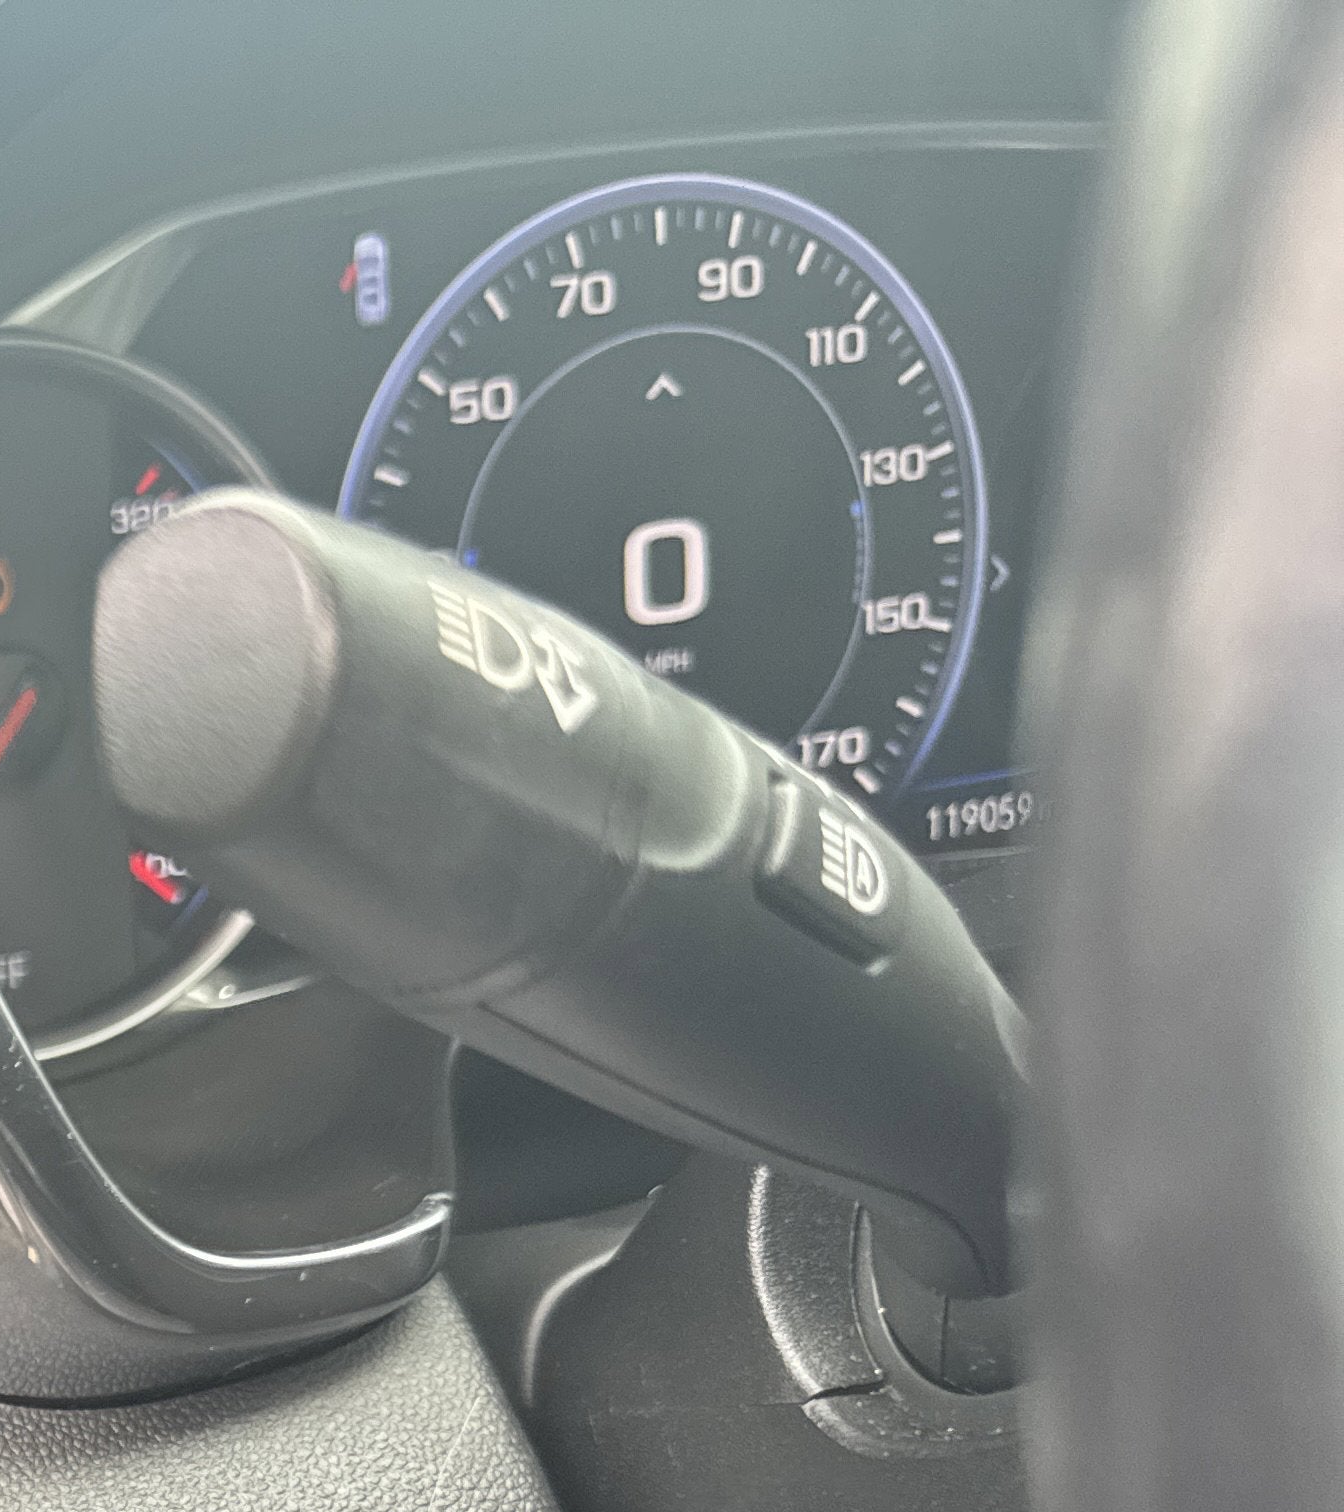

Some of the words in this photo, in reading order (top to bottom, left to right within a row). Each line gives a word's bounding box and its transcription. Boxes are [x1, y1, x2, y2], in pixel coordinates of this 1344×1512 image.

[550, 272, 615, 317] 70
[698, 258, 763, 299] 90
[807, 325, 866, 366] 110
[449, 380, 514, 424] 50
[860, 444, 927, 487] 130
[623, 519, 709, 626] 0
[861, 592, 929, 634] 150
[798, 727, 869, 768] 170
[926, 792, 1034, 841] 119059
